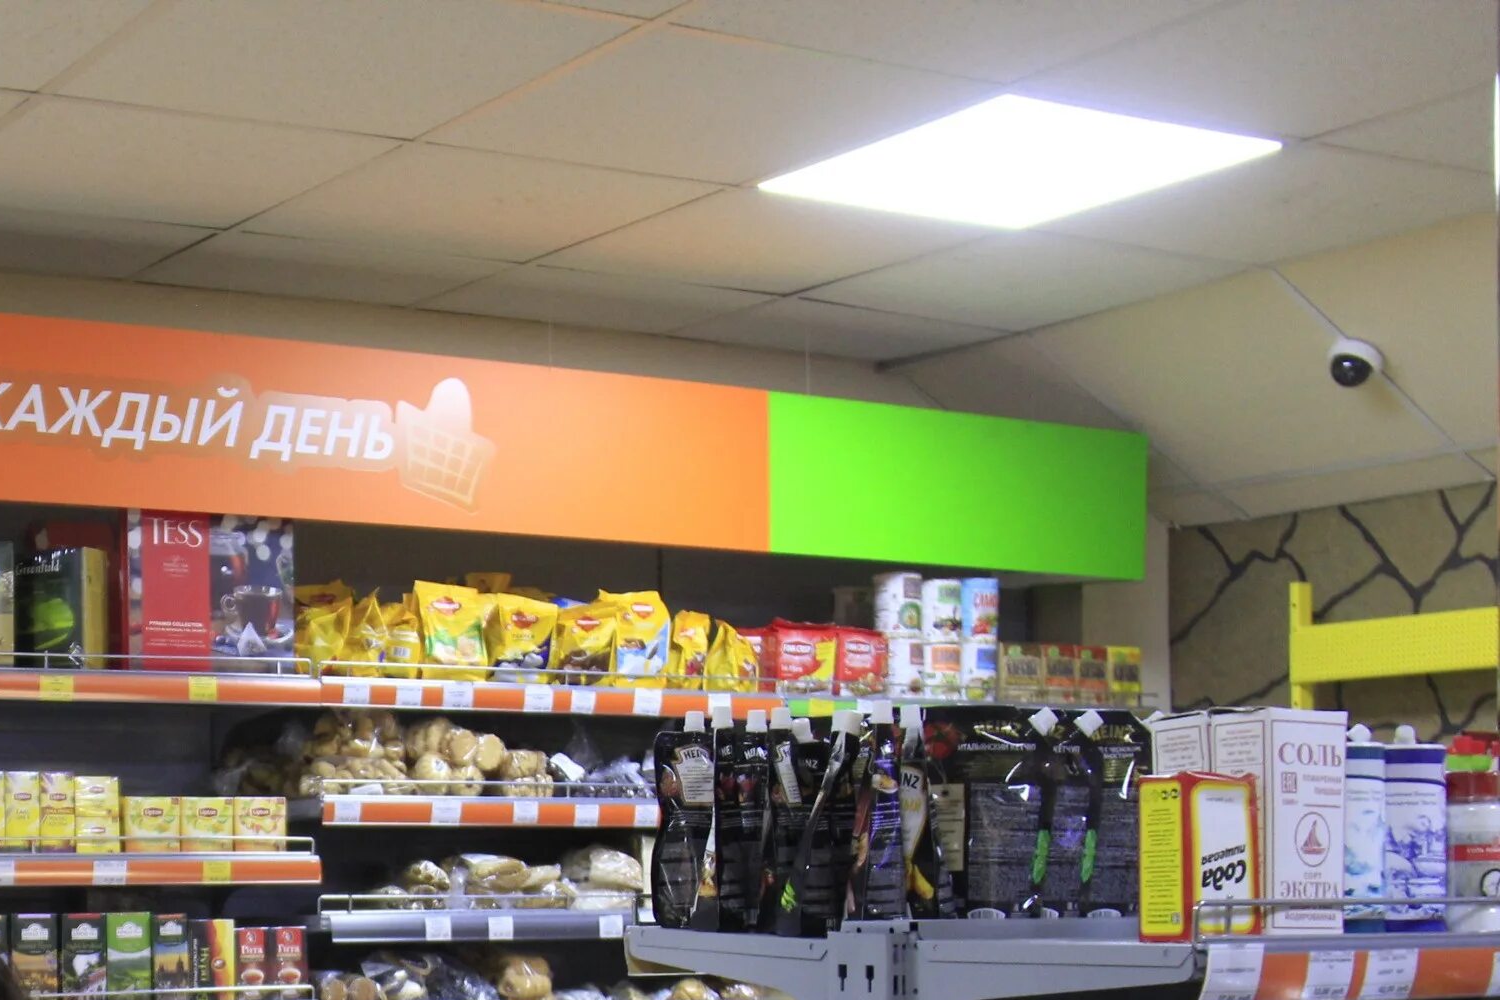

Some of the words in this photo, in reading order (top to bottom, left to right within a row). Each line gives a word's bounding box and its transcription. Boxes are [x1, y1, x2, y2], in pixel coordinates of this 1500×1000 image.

[249, 404, 395, 462] ДЕНЬ
[149, 517, 203, 548] TESS
[14, 559, 60, 576] Greenfield
[1278, 742, 1343, 768] СОЛЬ
[1201, 844, 1246, 864] пищевая
[1201, 859, 1248, 891] Сода
[1280, 880, 1339, 899] ЭКСТРА
